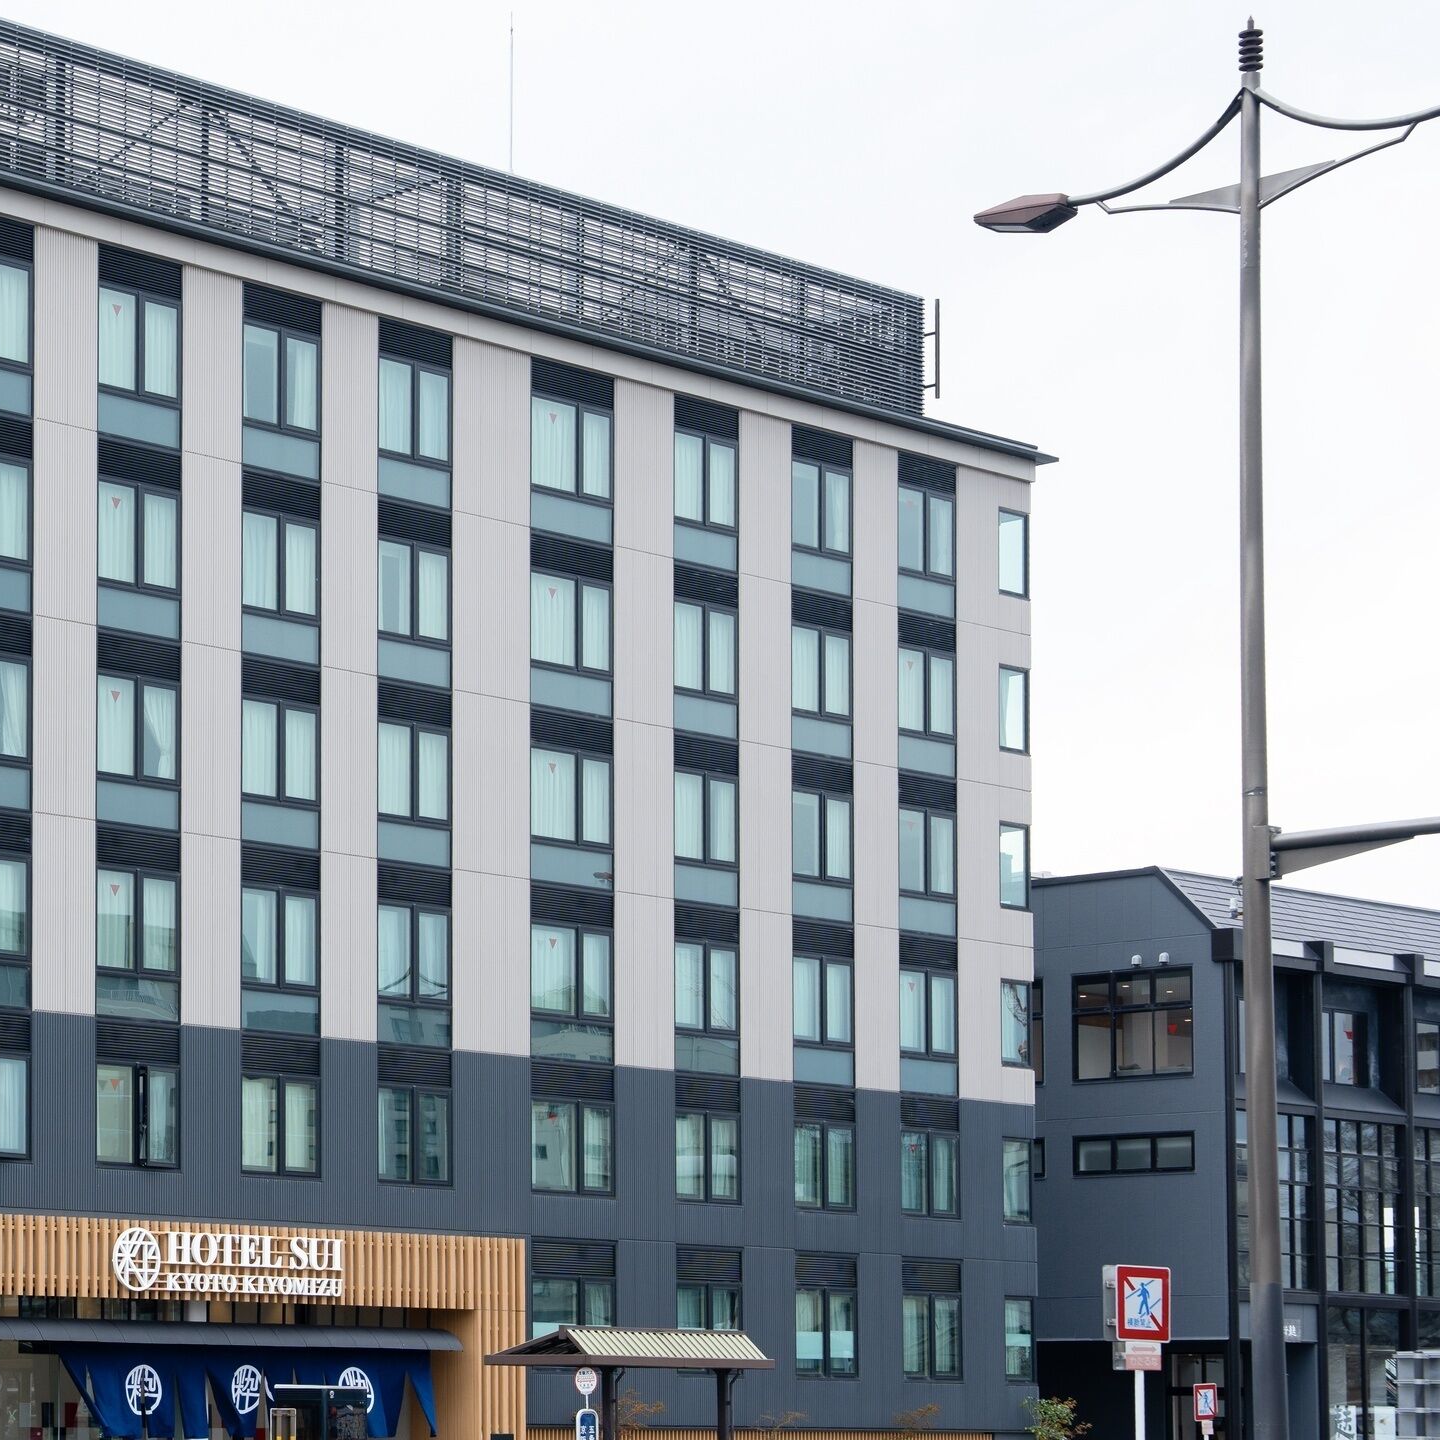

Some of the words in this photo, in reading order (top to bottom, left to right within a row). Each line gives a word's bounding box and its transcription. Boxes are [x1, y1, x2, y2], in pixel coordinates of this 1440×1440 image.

[166, 1231, 282, 1268] HOTEL
[289, 1236, 344, 1271] SUI
[166, 1272, 238, 1293] KYOTO
[242, 1276, 344, 1297] KIYOMIZU
